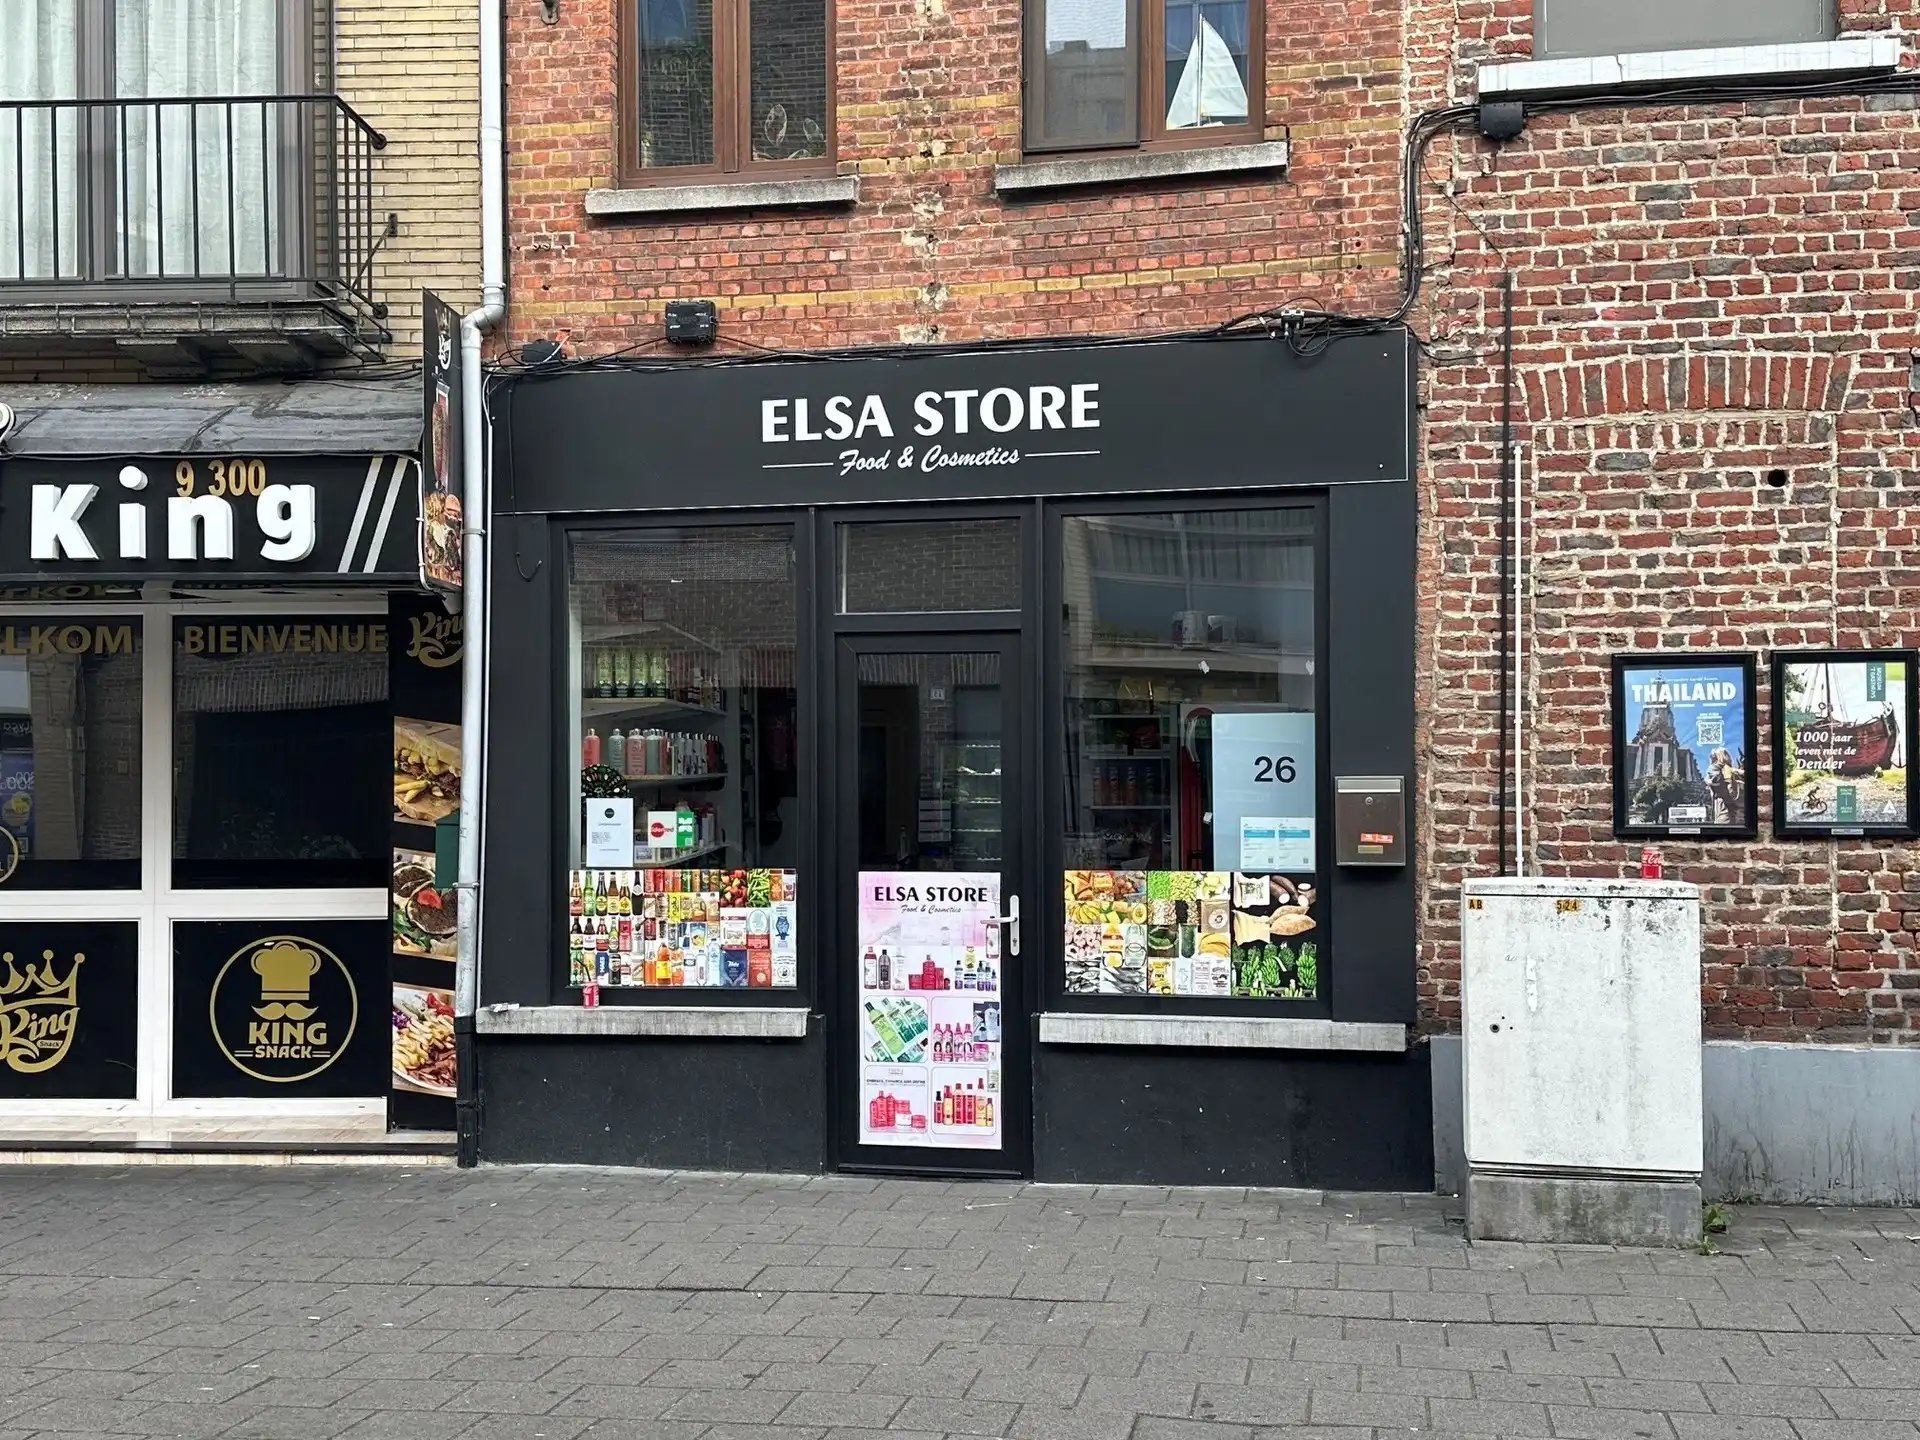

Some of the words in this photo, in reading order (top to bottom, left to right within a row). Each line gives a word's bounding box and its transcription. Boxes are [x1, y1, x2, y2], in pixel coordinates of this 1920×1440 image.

[761, 394, 895, 442] ELSA
[913, 383, 1101, 437] STORE
[838, 448, 890, 476] Food
[897, 446, 914, 469] &
[920, 445, 1021, 473] Cosmetics
[175, 461, 195, 497] 9
[208, 459, 267, 496] 300
[31, 465, 316, 562] King
[0, 625, 132, 654] LKOM
[184, 624, 388, 653] BIENVENUE
[1631, 681, 1737, 703] THAILAND
[1795, 746, 1821, 756] leven
[1822, 747, 1842, 756] met
[1844, 746, 1857, 755] de
[1831, 732, 1853, 746] jaar
[1253, 756, 1297, 784] 26
[1796, 758, 1846, 770] Dender
[874, 886, 920, 902] ELSA
[926, 886, 988, 903] STORE
[1556, 900, 1578, 911] 524
[900, 904, 918, 914] Food
[920, 904, 926, 912] &
[928, 904, 962, 915] Cosmetics
[0, 1006, 81, 1074] King
[248, 1021, 328, 1046] KING
[254, 1045, 313, 1058] SNACK
